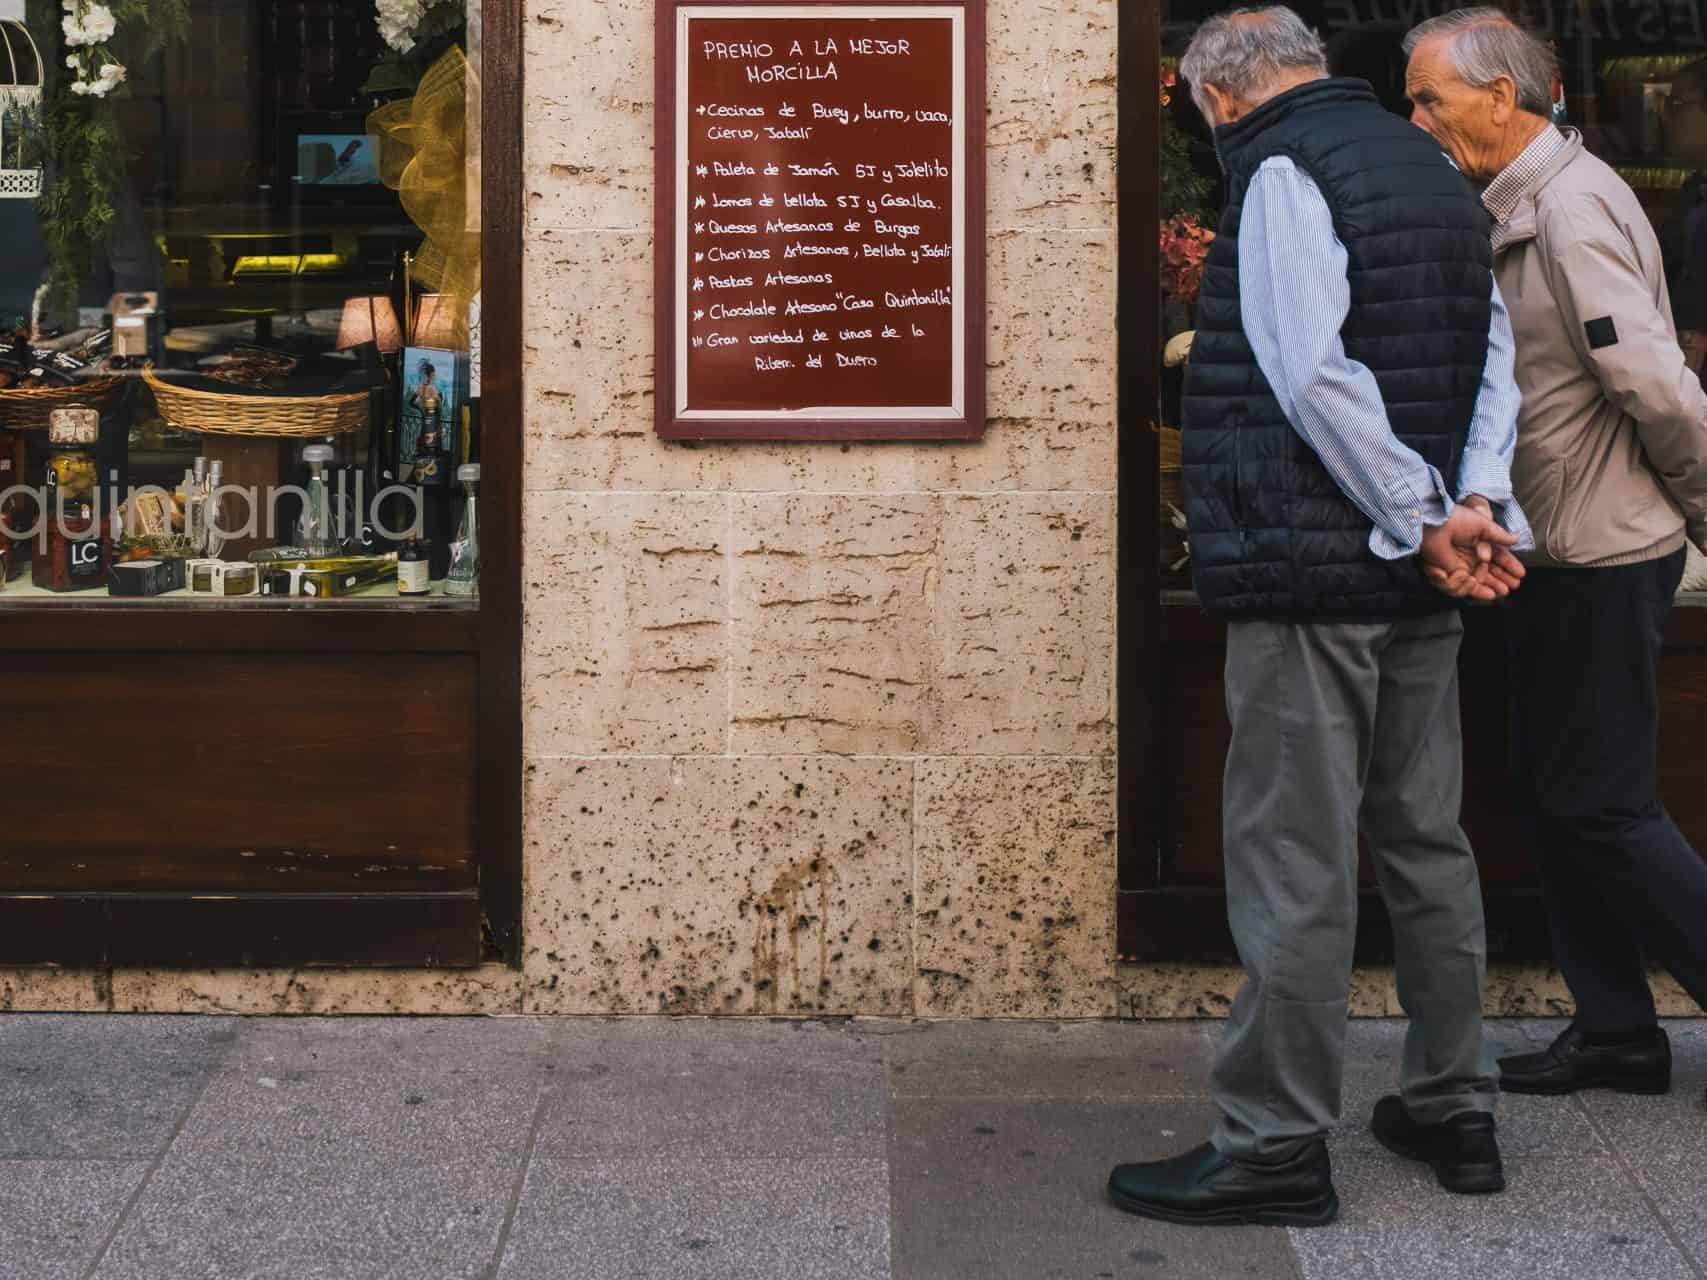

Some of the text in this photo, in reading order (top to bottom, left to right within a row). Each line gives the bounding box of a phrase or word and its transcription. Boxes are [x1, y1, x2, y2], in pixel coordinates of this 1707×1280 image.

[704, 38, 911, 60] PREMIO A LA MEJOR
[746, 62, 838, 84] MORCILLA
[707, 103, 765, 117] Cecinas
[778, 102, 796, 117] de
[713, 161, 755, 176] Paleta
[763, 163, 779, 176] de
[788, 162, 840, 177] Jamón
[882, 169, 894, 184] y
[759, 193, 775, 208] de
[783, 192, 828, 208] bellota
[866, 197, 878, 214] y
[843, 221, 861, 233] de
[862, 242, 907, 258] Bellota
[910, 250, 920, 265] y
[709, 298, 778, 320] Chocolate
[706, 323, 926, 348] Gran variedad de vinos de la
[0, 468, 424, 556] quintanilla
[71, 542, 99, 565] LC
